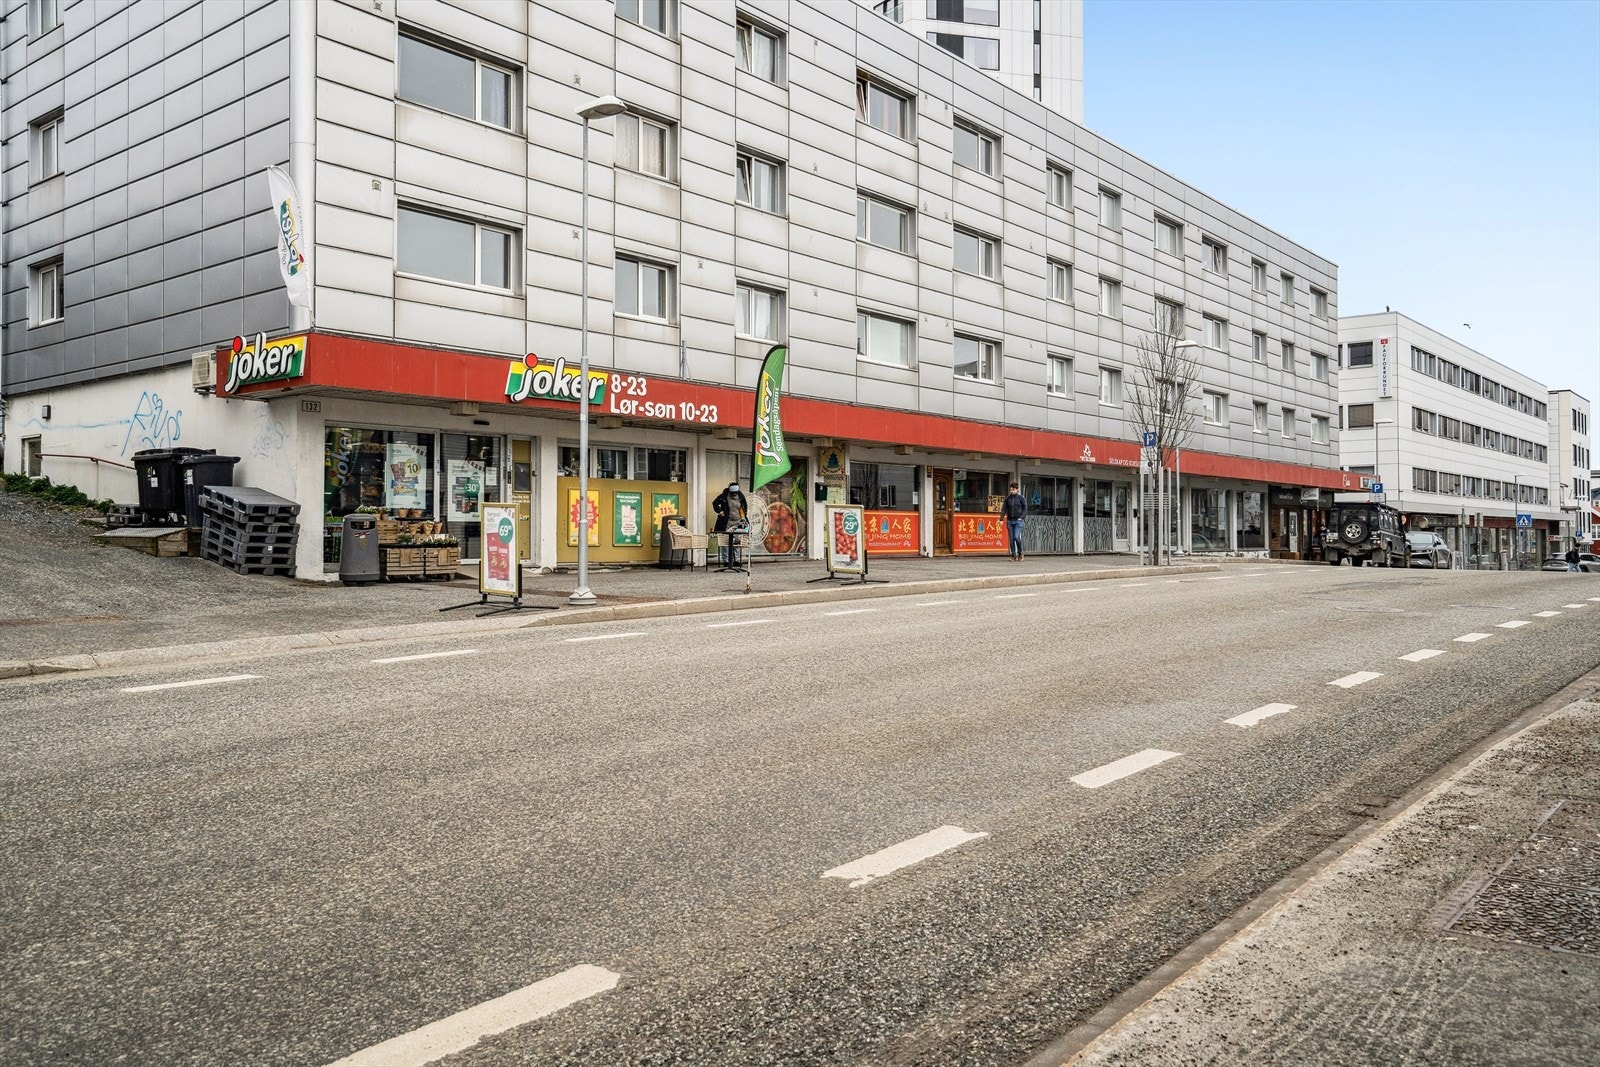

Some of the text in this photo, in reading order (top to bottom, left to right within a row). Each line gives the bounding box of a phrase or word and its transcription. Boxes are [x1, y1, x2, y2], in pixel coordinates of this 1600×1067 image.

[224, 332, 298, 394] joker
[511, 352, 605, 402] joker
[611, 374, 647, 396] 8-23
[306, 402, 318, 411] 132
[610, 393, 718, 423] Lør-søn 10-23
[756, 380, 783, 463] joker
[407, 463, 419, 474] 10
